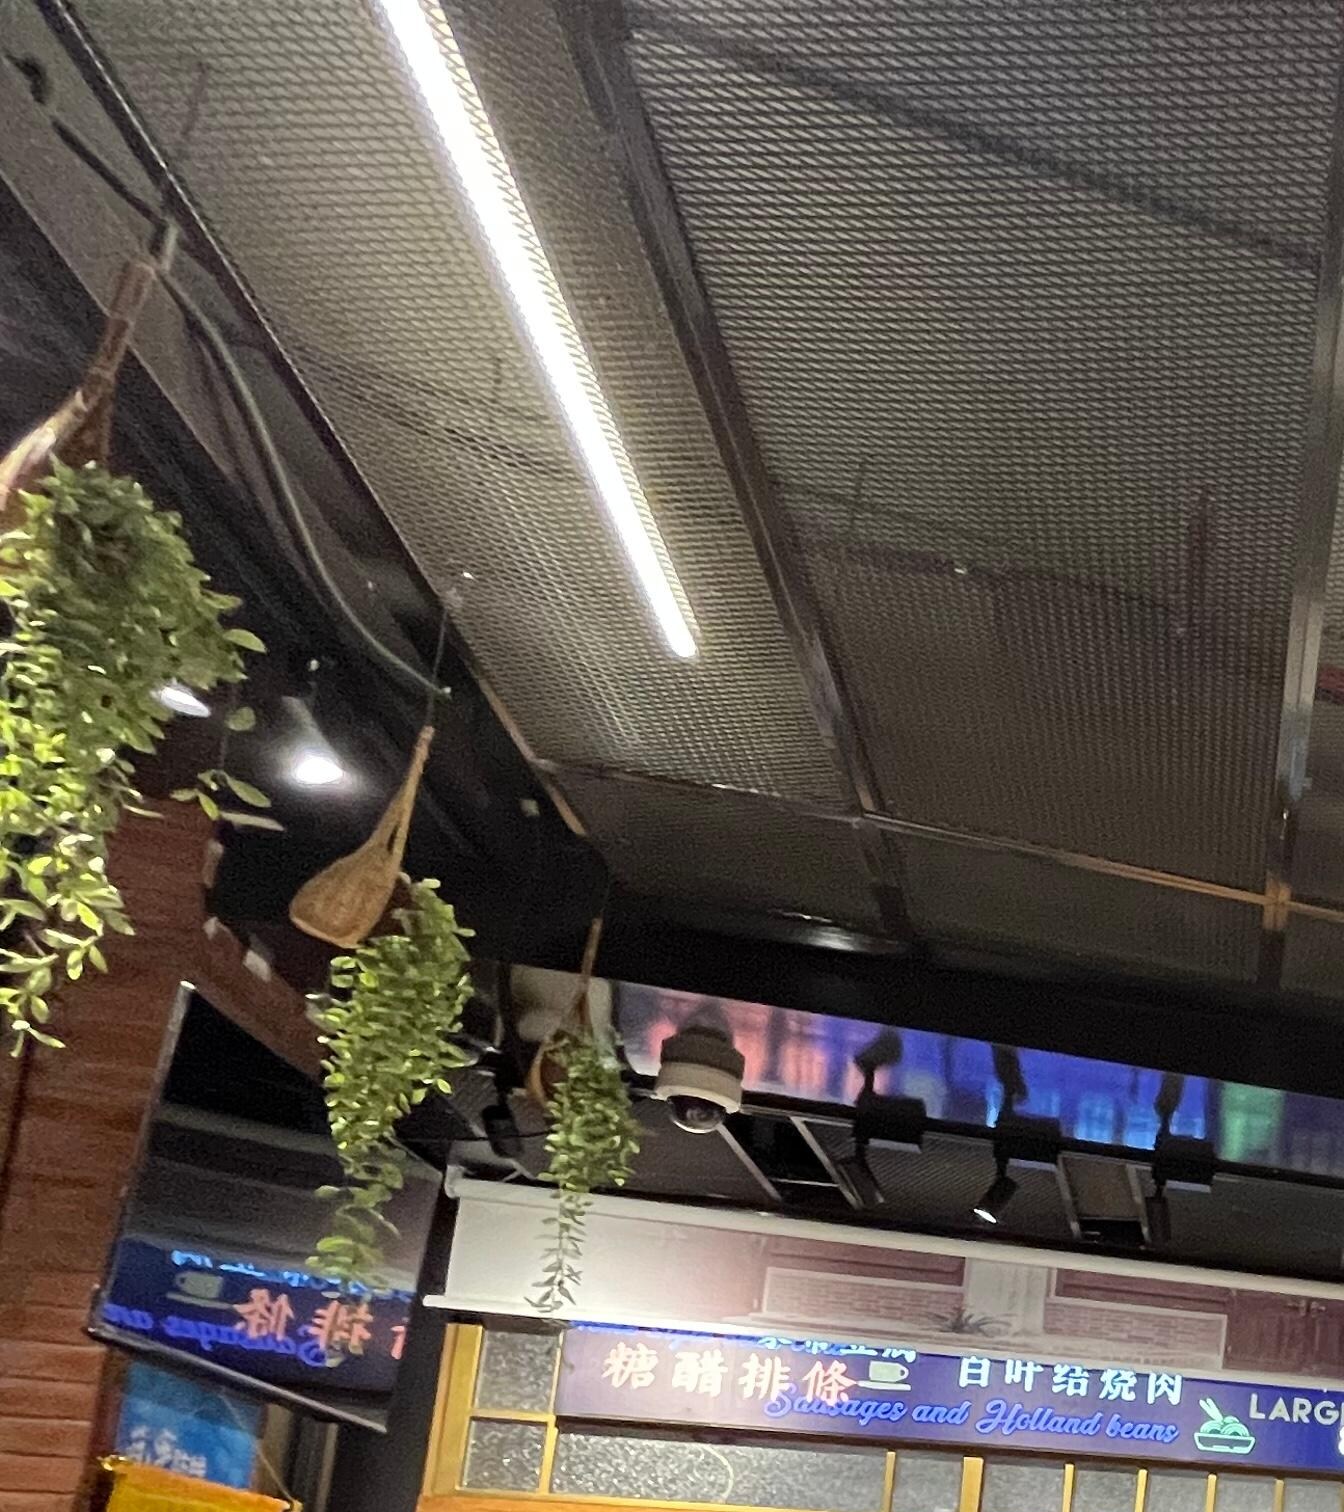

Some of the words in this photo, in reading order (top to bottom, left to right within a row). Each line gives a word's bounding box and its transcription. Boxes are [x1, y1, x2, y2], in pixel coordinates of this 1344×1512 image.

[764, 1383, 906, 1427] Sausages
[911, 1400, 973, 1426] and
[975, 1399, 1103, 1437] Holland
[1104, 1412, 1180, 1445] beans
